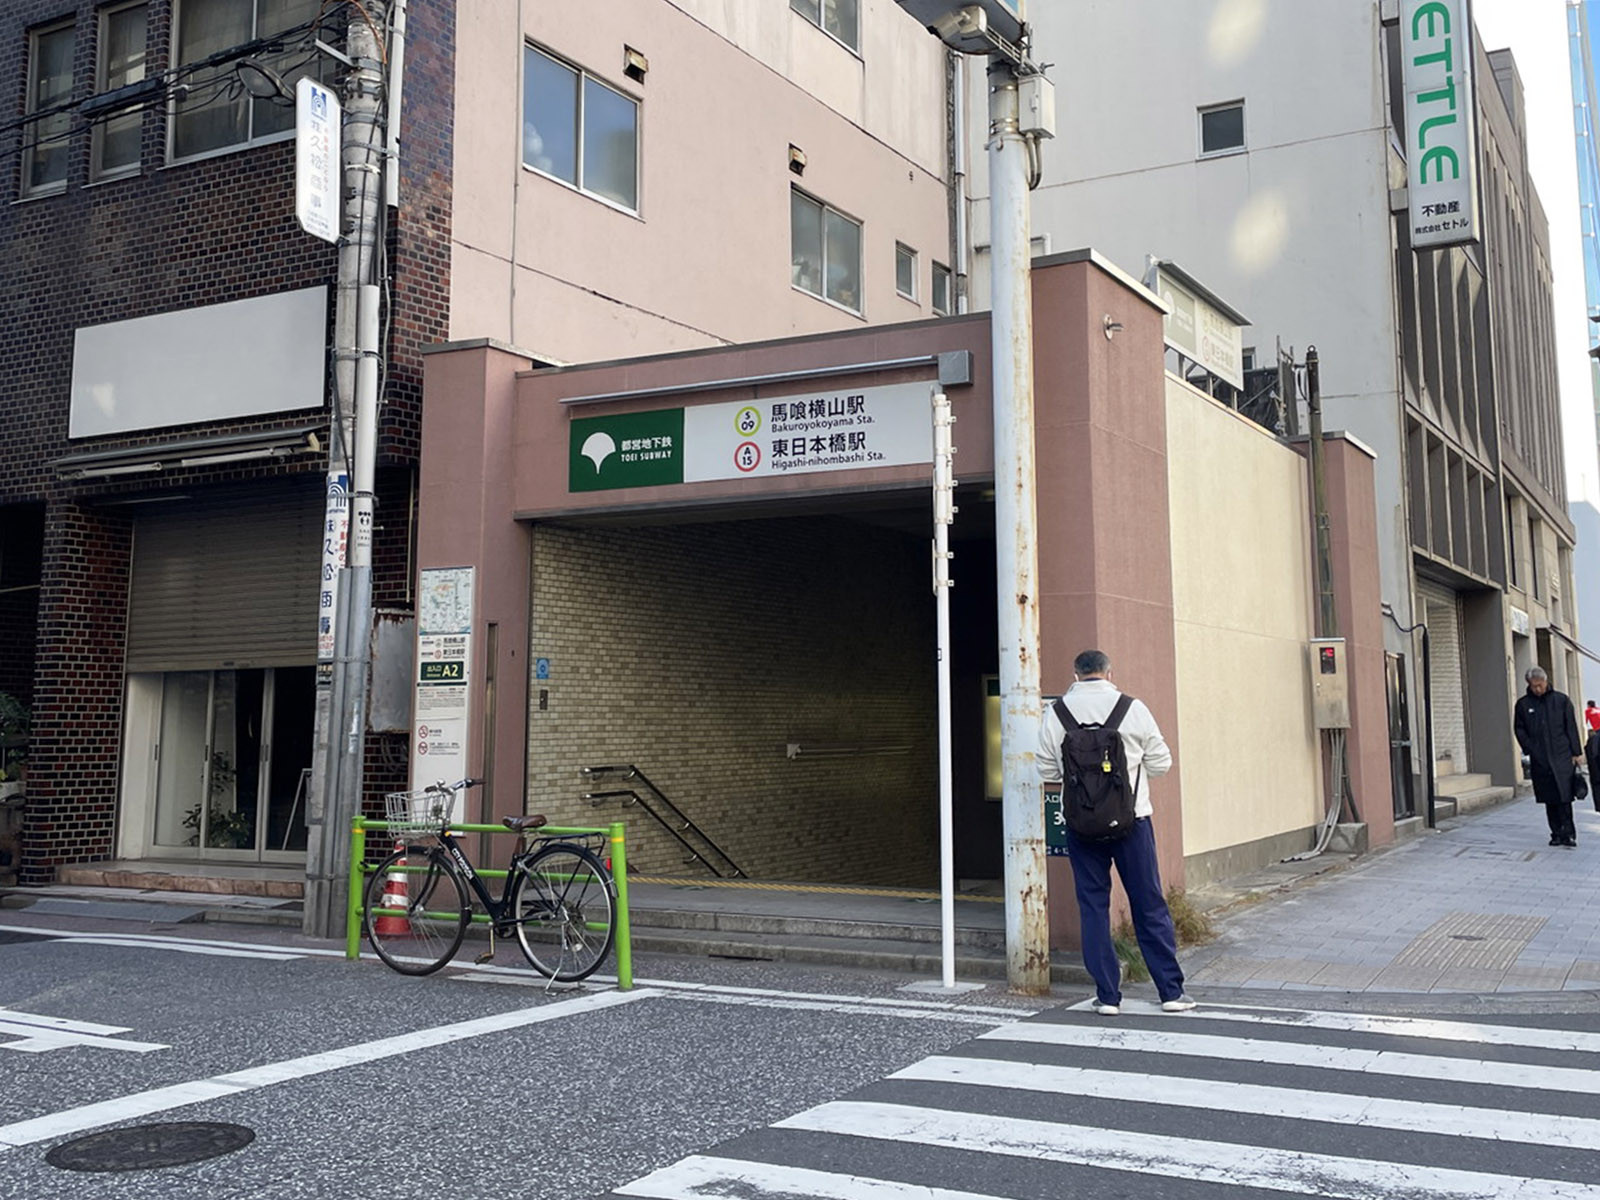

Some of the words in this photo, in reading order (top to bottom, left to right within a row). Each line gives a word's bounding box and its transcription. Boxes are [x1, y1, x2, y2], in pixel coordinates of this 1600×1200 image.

[1422, 201, 1460, 217] 不動産
[745, 411, 751, 420] S
[771, 395, 865, 422] 馬喰横山駅
[741, 420, 755, 431] 09
[771, 418, 854, 433] Bakuroyokoyama
[857, 414, 876, 424] Sta.
[621, 436, 672, 451] 都営地下鉄
[771, 431, 866, 458] 東日本橋駅
[621, 452, 638, 462] TOEI
[640, 450, 672, 461] SUBWAY
[744, 447, 751, 455] A
[742, 456, 753, 466] 15
[771, 452, 864, 471] Higashi-nihombashi
[867, 451, 887, 462] Sta.
[442, 664, 459, 677] A2
